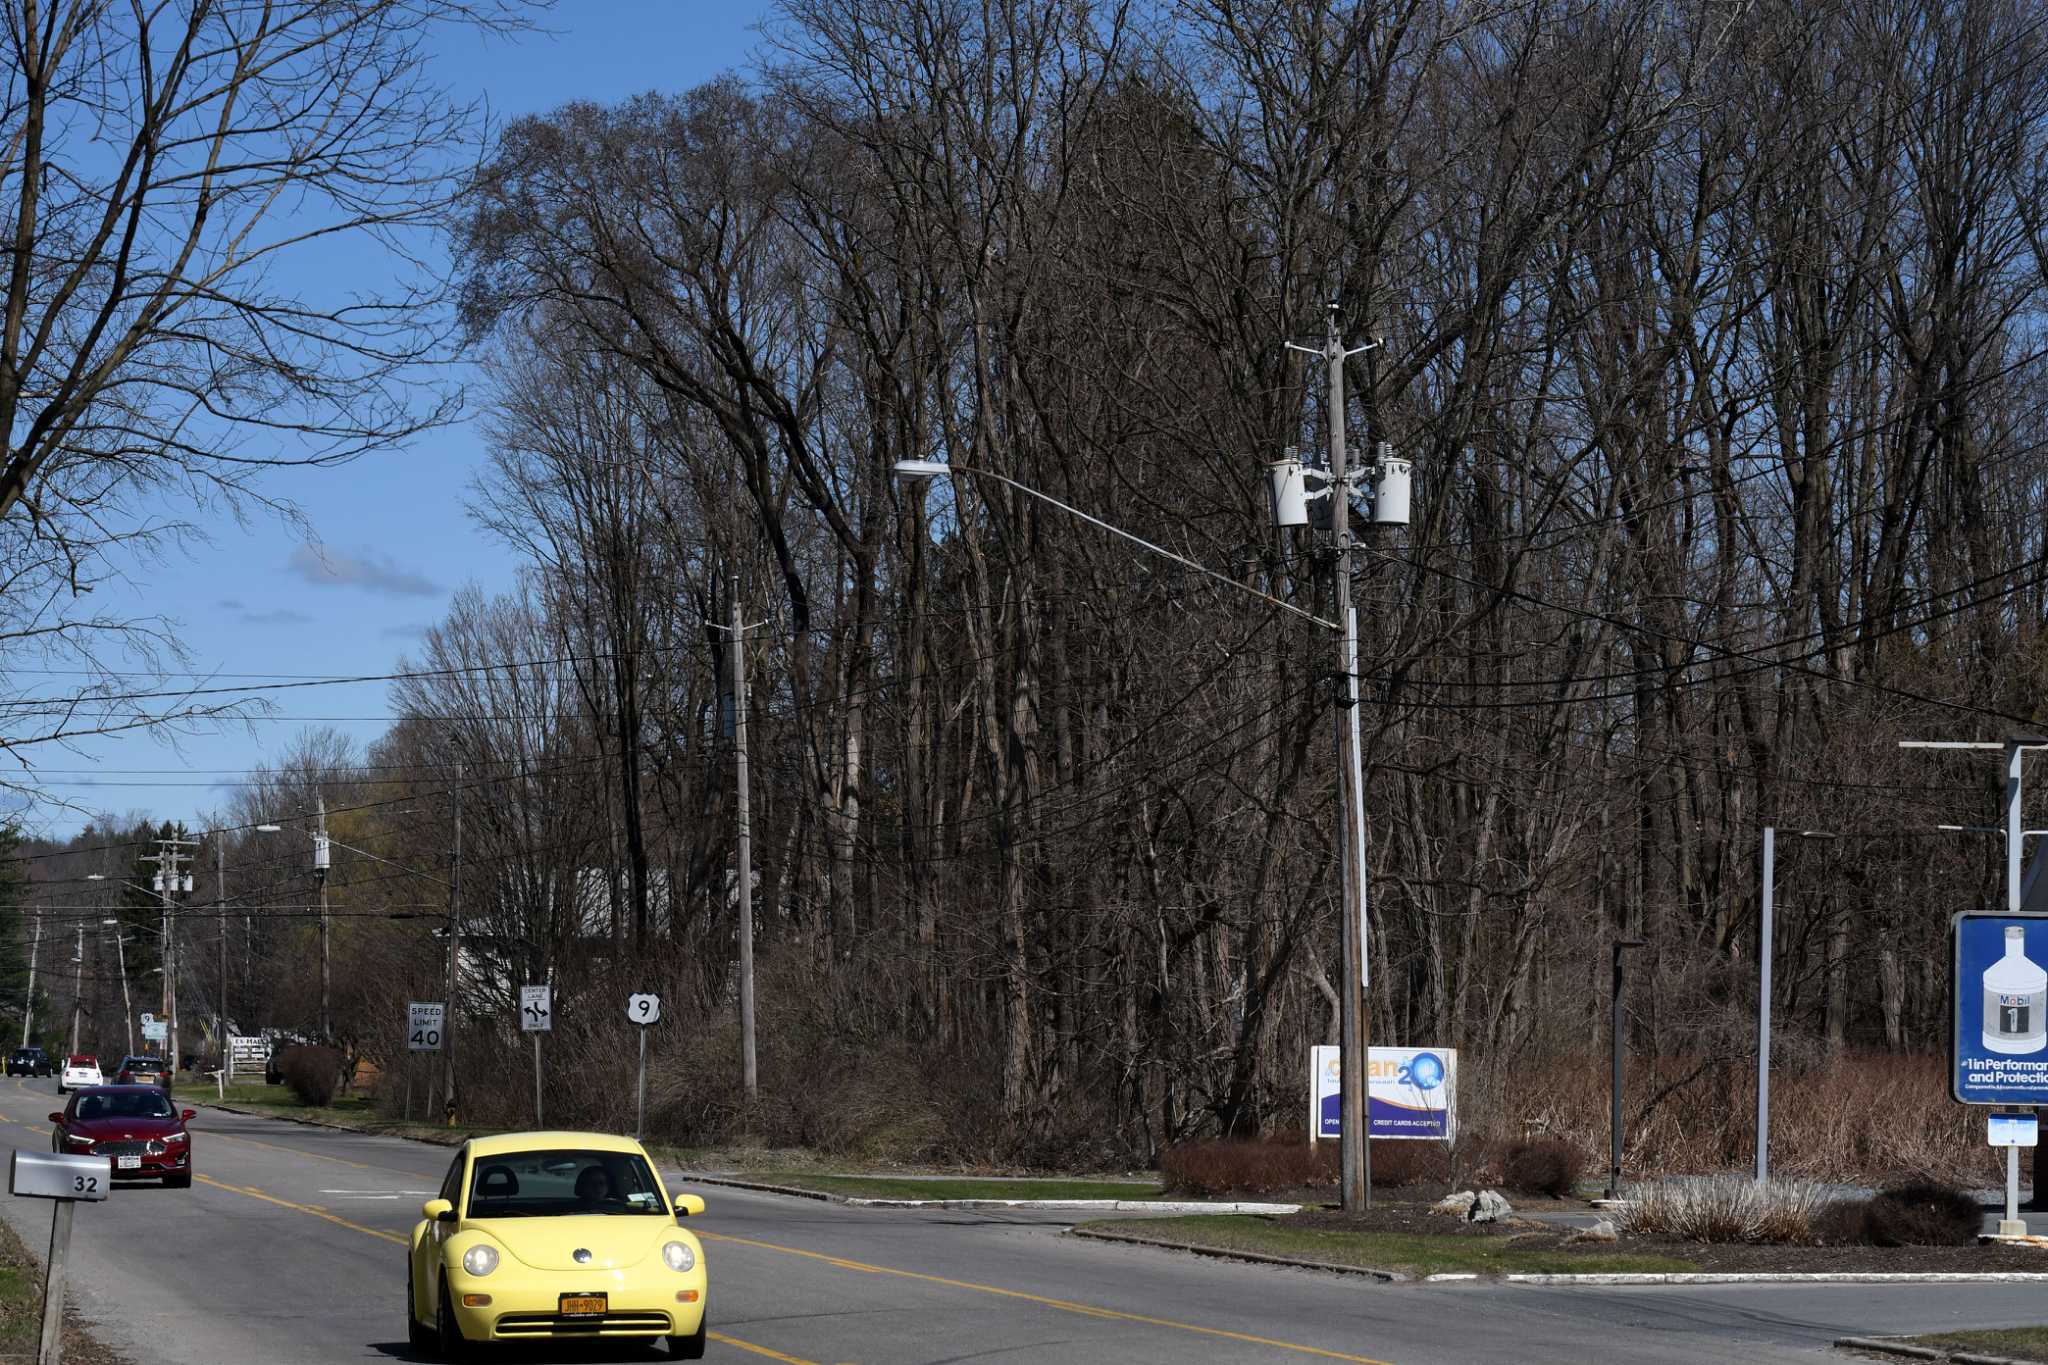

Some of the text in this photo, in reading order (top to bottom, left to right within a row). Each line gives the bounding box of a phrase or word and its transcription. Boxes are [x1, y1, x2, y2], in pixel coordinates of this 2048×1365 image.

[2000, 994, 2031, 1006] Mobil
[411, 1007, 441, 1016] SPEED
[638, 1000, 650, 1017] 9
[414, 1018, 438, 1026] LIMIT
[2008, 1007, 2018, 1032] 1
[411, 1030, 439, 1046] 40
[1973, 1058, 1985, 1070] in
[1985, 1058, 2048, 1071] Performa
[1968, 1071, 1994, 1083] and
[74, 1176, 98, 1193] 32
